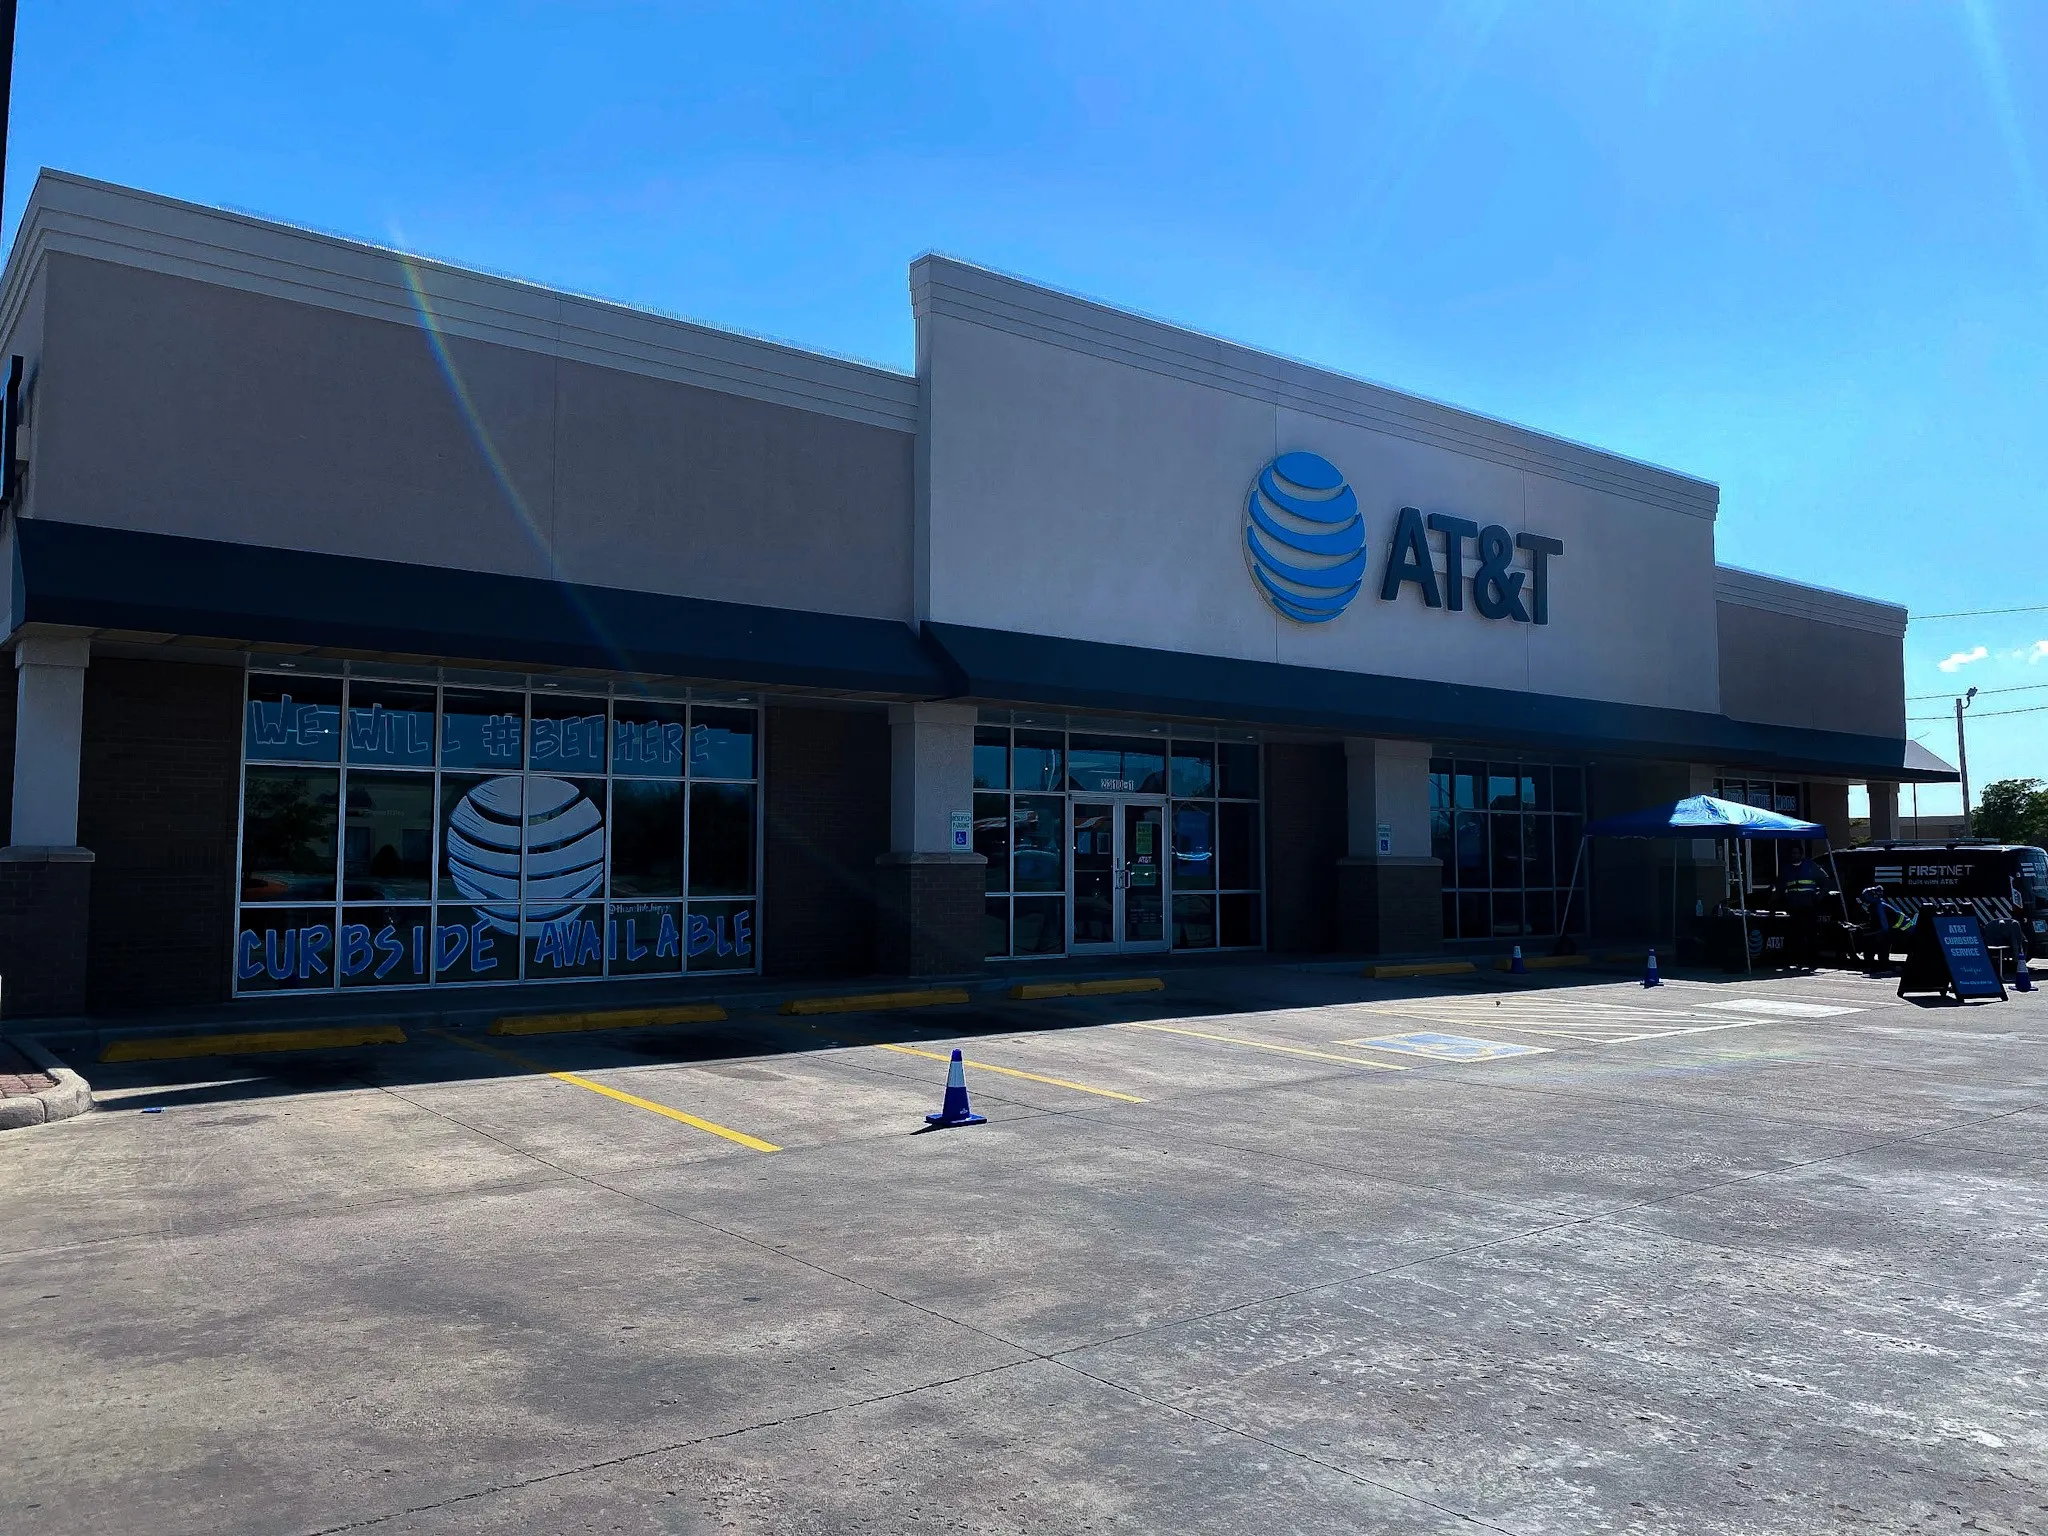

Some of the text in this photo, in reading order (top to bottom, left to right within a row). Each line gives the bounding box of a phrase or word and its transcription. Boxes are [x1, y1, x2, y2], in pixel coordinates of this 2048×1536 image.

[1380, 506, 1564, 626] AT&T
[252, 693, 709, 763] WE WILL #BETHERE
[1138, 856, 1152, 864] AT&T
[1908, 864, 1974, 876] FIRSTNET
[1949, 924, 1967, 934] AT&T
[238, 910, 752, 980] CURBSIDE AVAILABLE
[1766, 936, 1785, 949] AT&T
[1950, 947, 1981, 957] SERVICE
